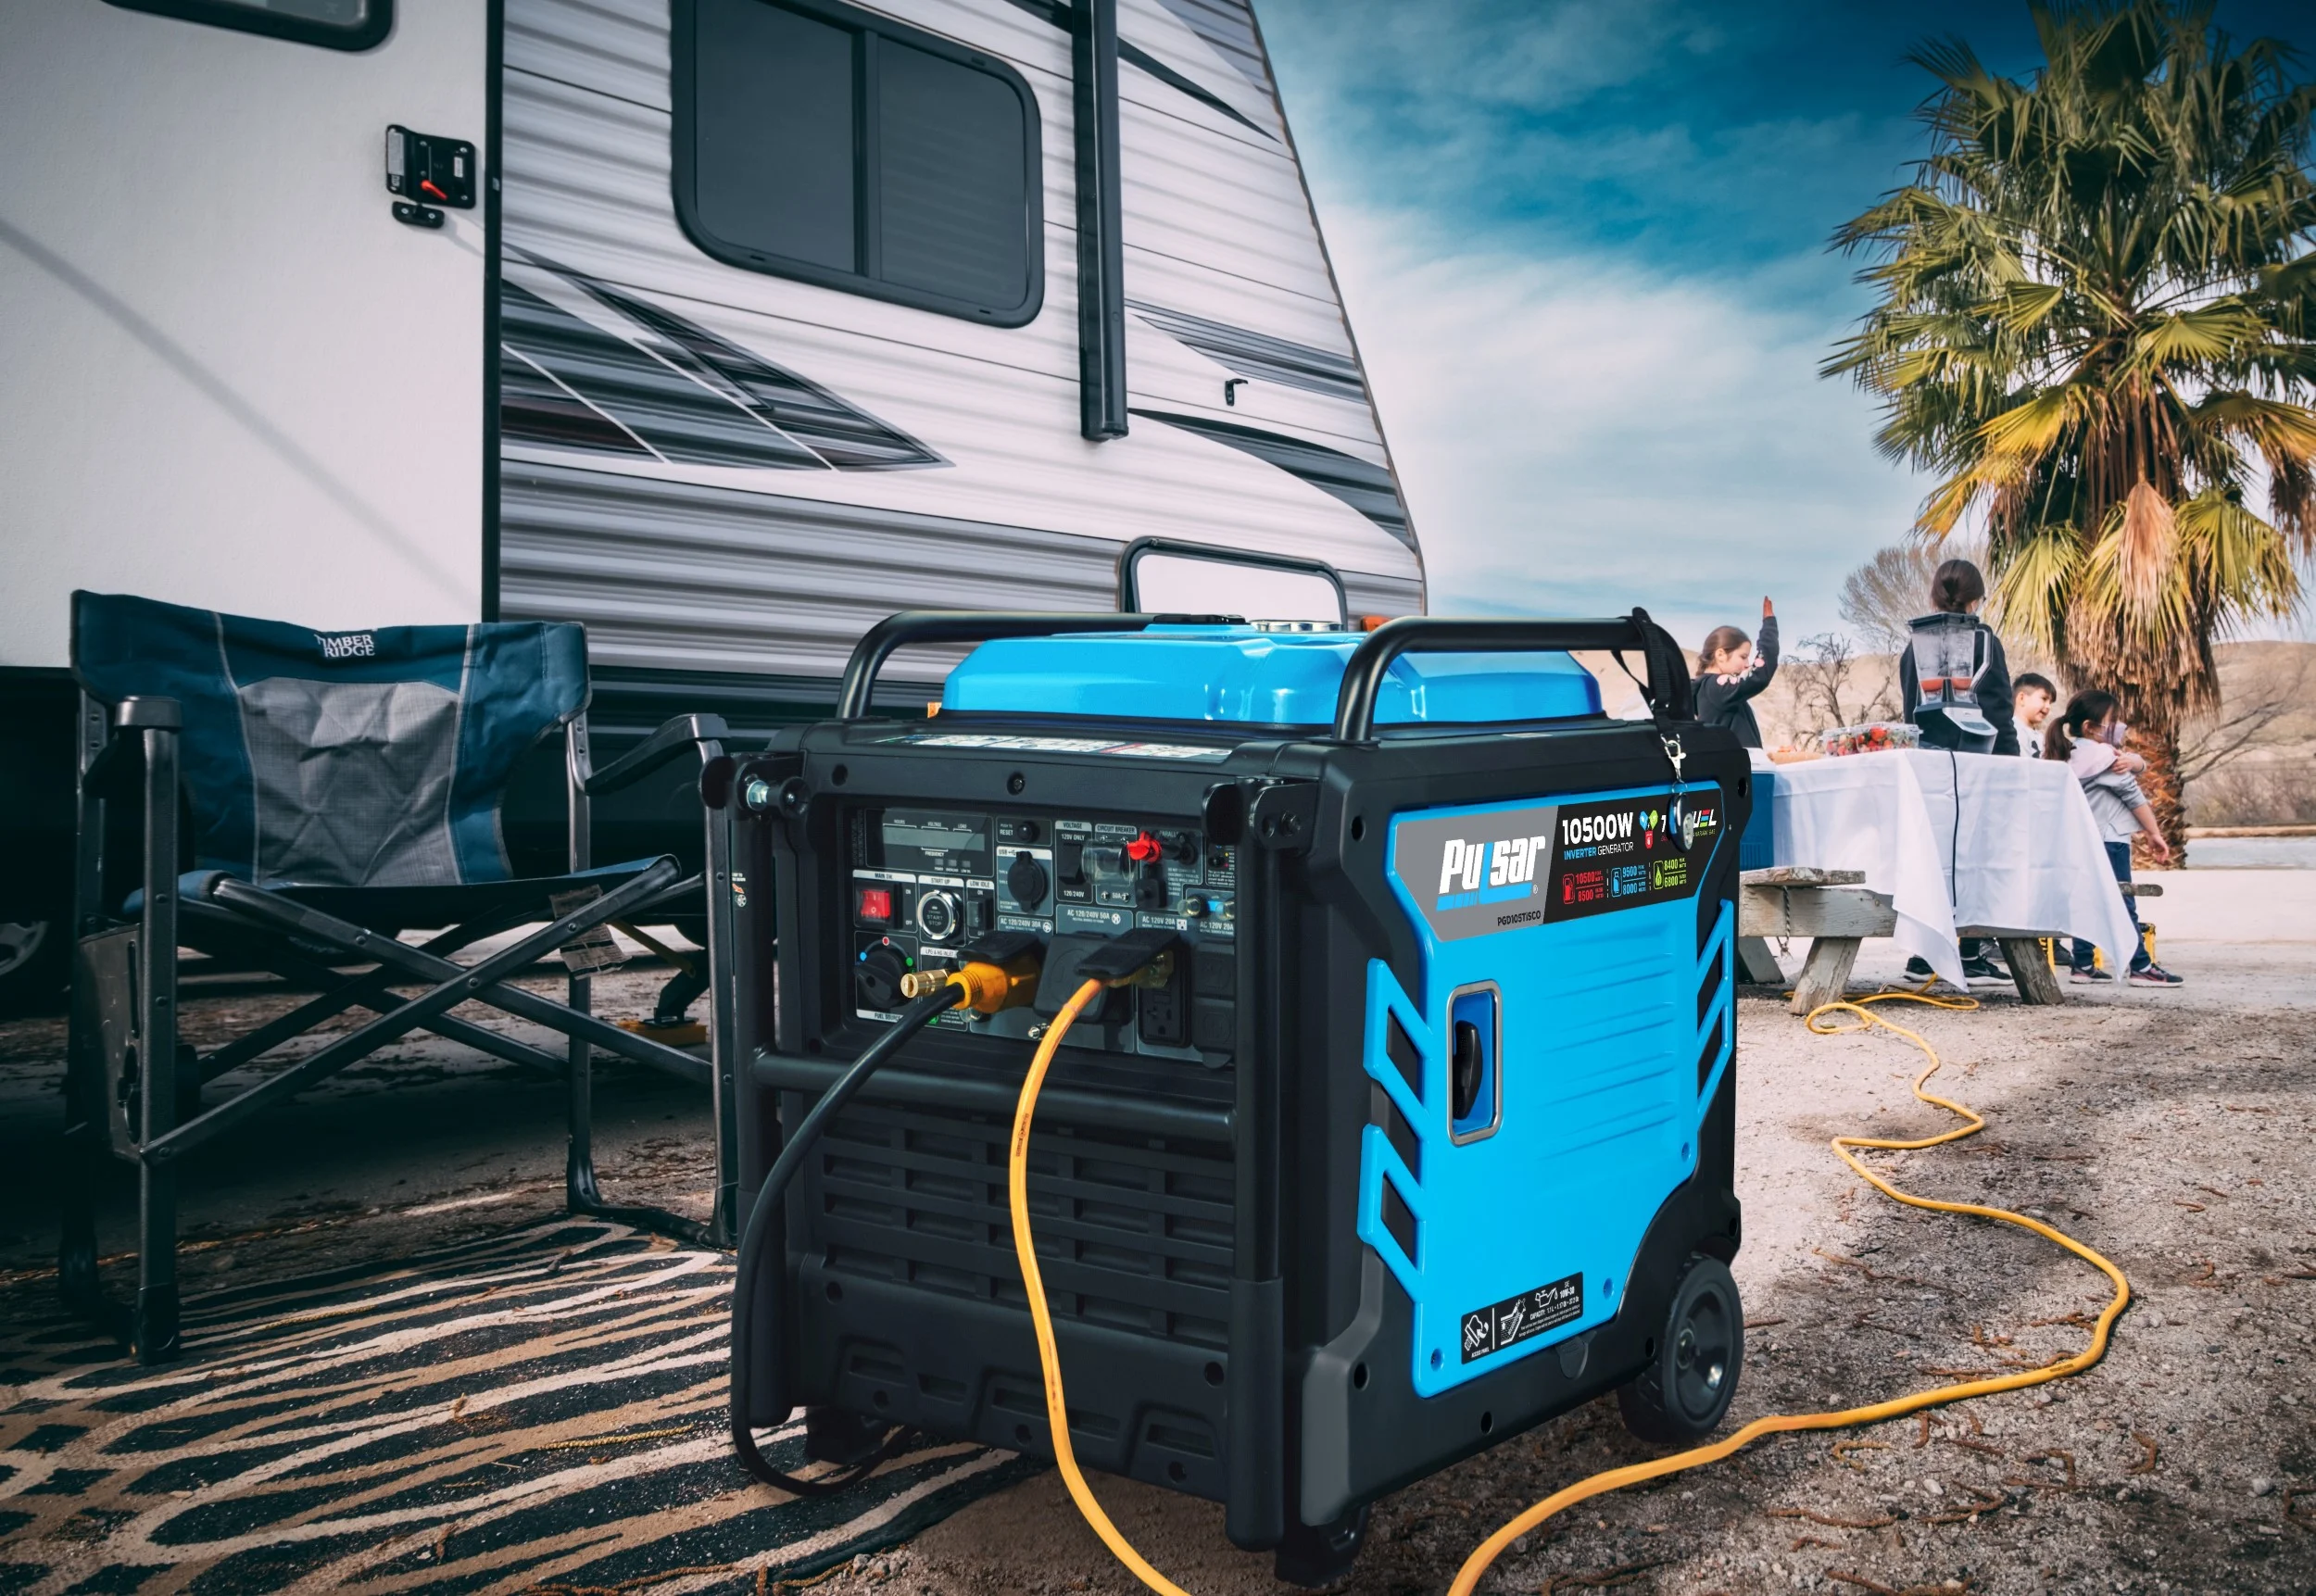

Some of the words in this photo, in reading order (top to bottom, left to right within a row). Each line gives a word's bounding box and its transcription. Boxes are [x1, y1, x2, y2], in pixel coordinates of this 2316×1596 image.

[324, 645, 375, 658] RIDGE
[1562, 811, 1634, 846] 10500W
[1564, 846, 1597, 861] INVERTER
[1597, 841, 1634, 856] GENERATOR
[1664, 859, 1678, 871] 8400
[1576, 872, 1595, 884] 10500
[1622, 866, 1637, 878] 9500
[1664, 875, 1679, 887] 6800
[1622, 883, 1637, 895] 8000
[1578, 889, 1593, 902] 8500
[1208, 922, 1223, 930] 120V
[1559, 1286, 1575, 1299] 10W-30
